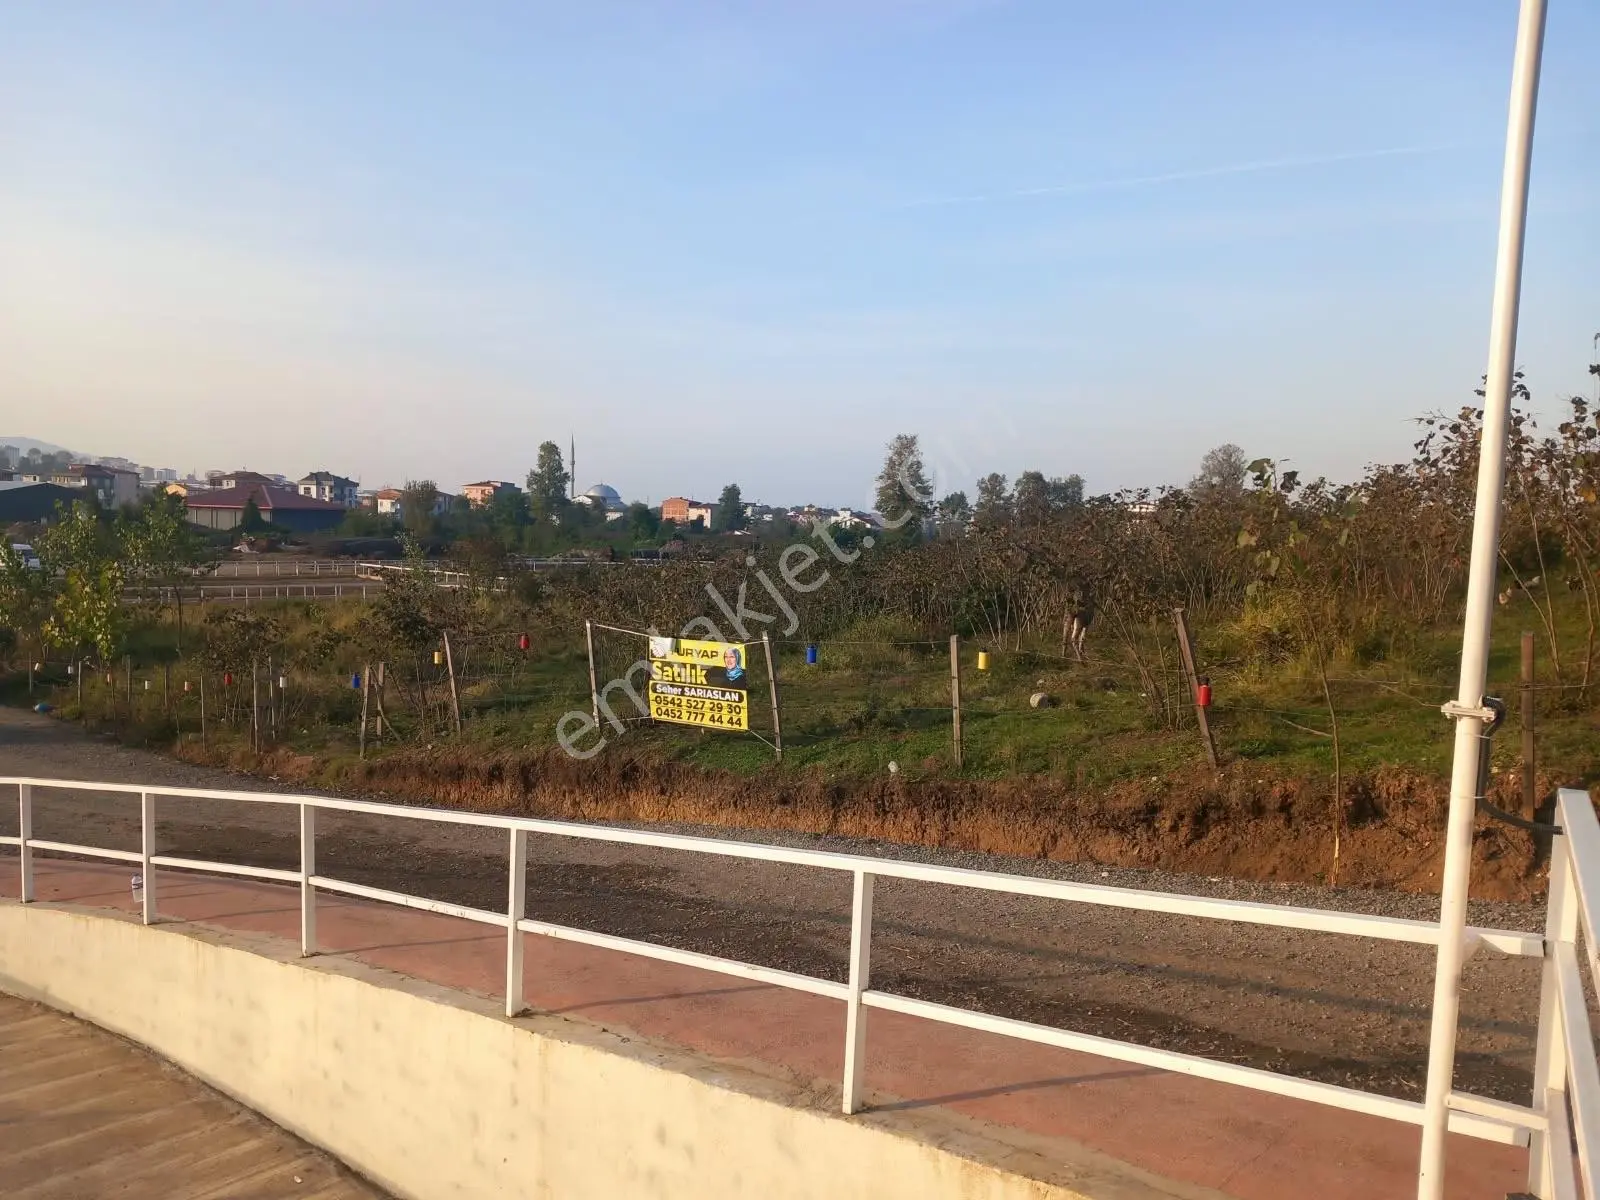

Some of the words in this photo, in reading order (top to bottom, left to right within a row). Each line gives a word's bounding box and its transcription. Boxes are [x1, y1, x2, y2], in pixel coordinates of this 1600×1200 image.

[671, 647, 718, 659] URYAP
[652, 661, 708, 685] Satılık
[656, 684, 682, 694] Seher
[684, 686, 739, 702] SARIASLAN
[654, 695, 683, 708] 0542
[686, 699, 706, 710] 527
[709, 702, 723, 713] 29
[727, 703, 742, 715] 30
[656, 707, 683, 720] 0452
[686, 710, 706, 723] 777
[709, 713, 724, 725] 44
[727, 716, 742, 728] 44
